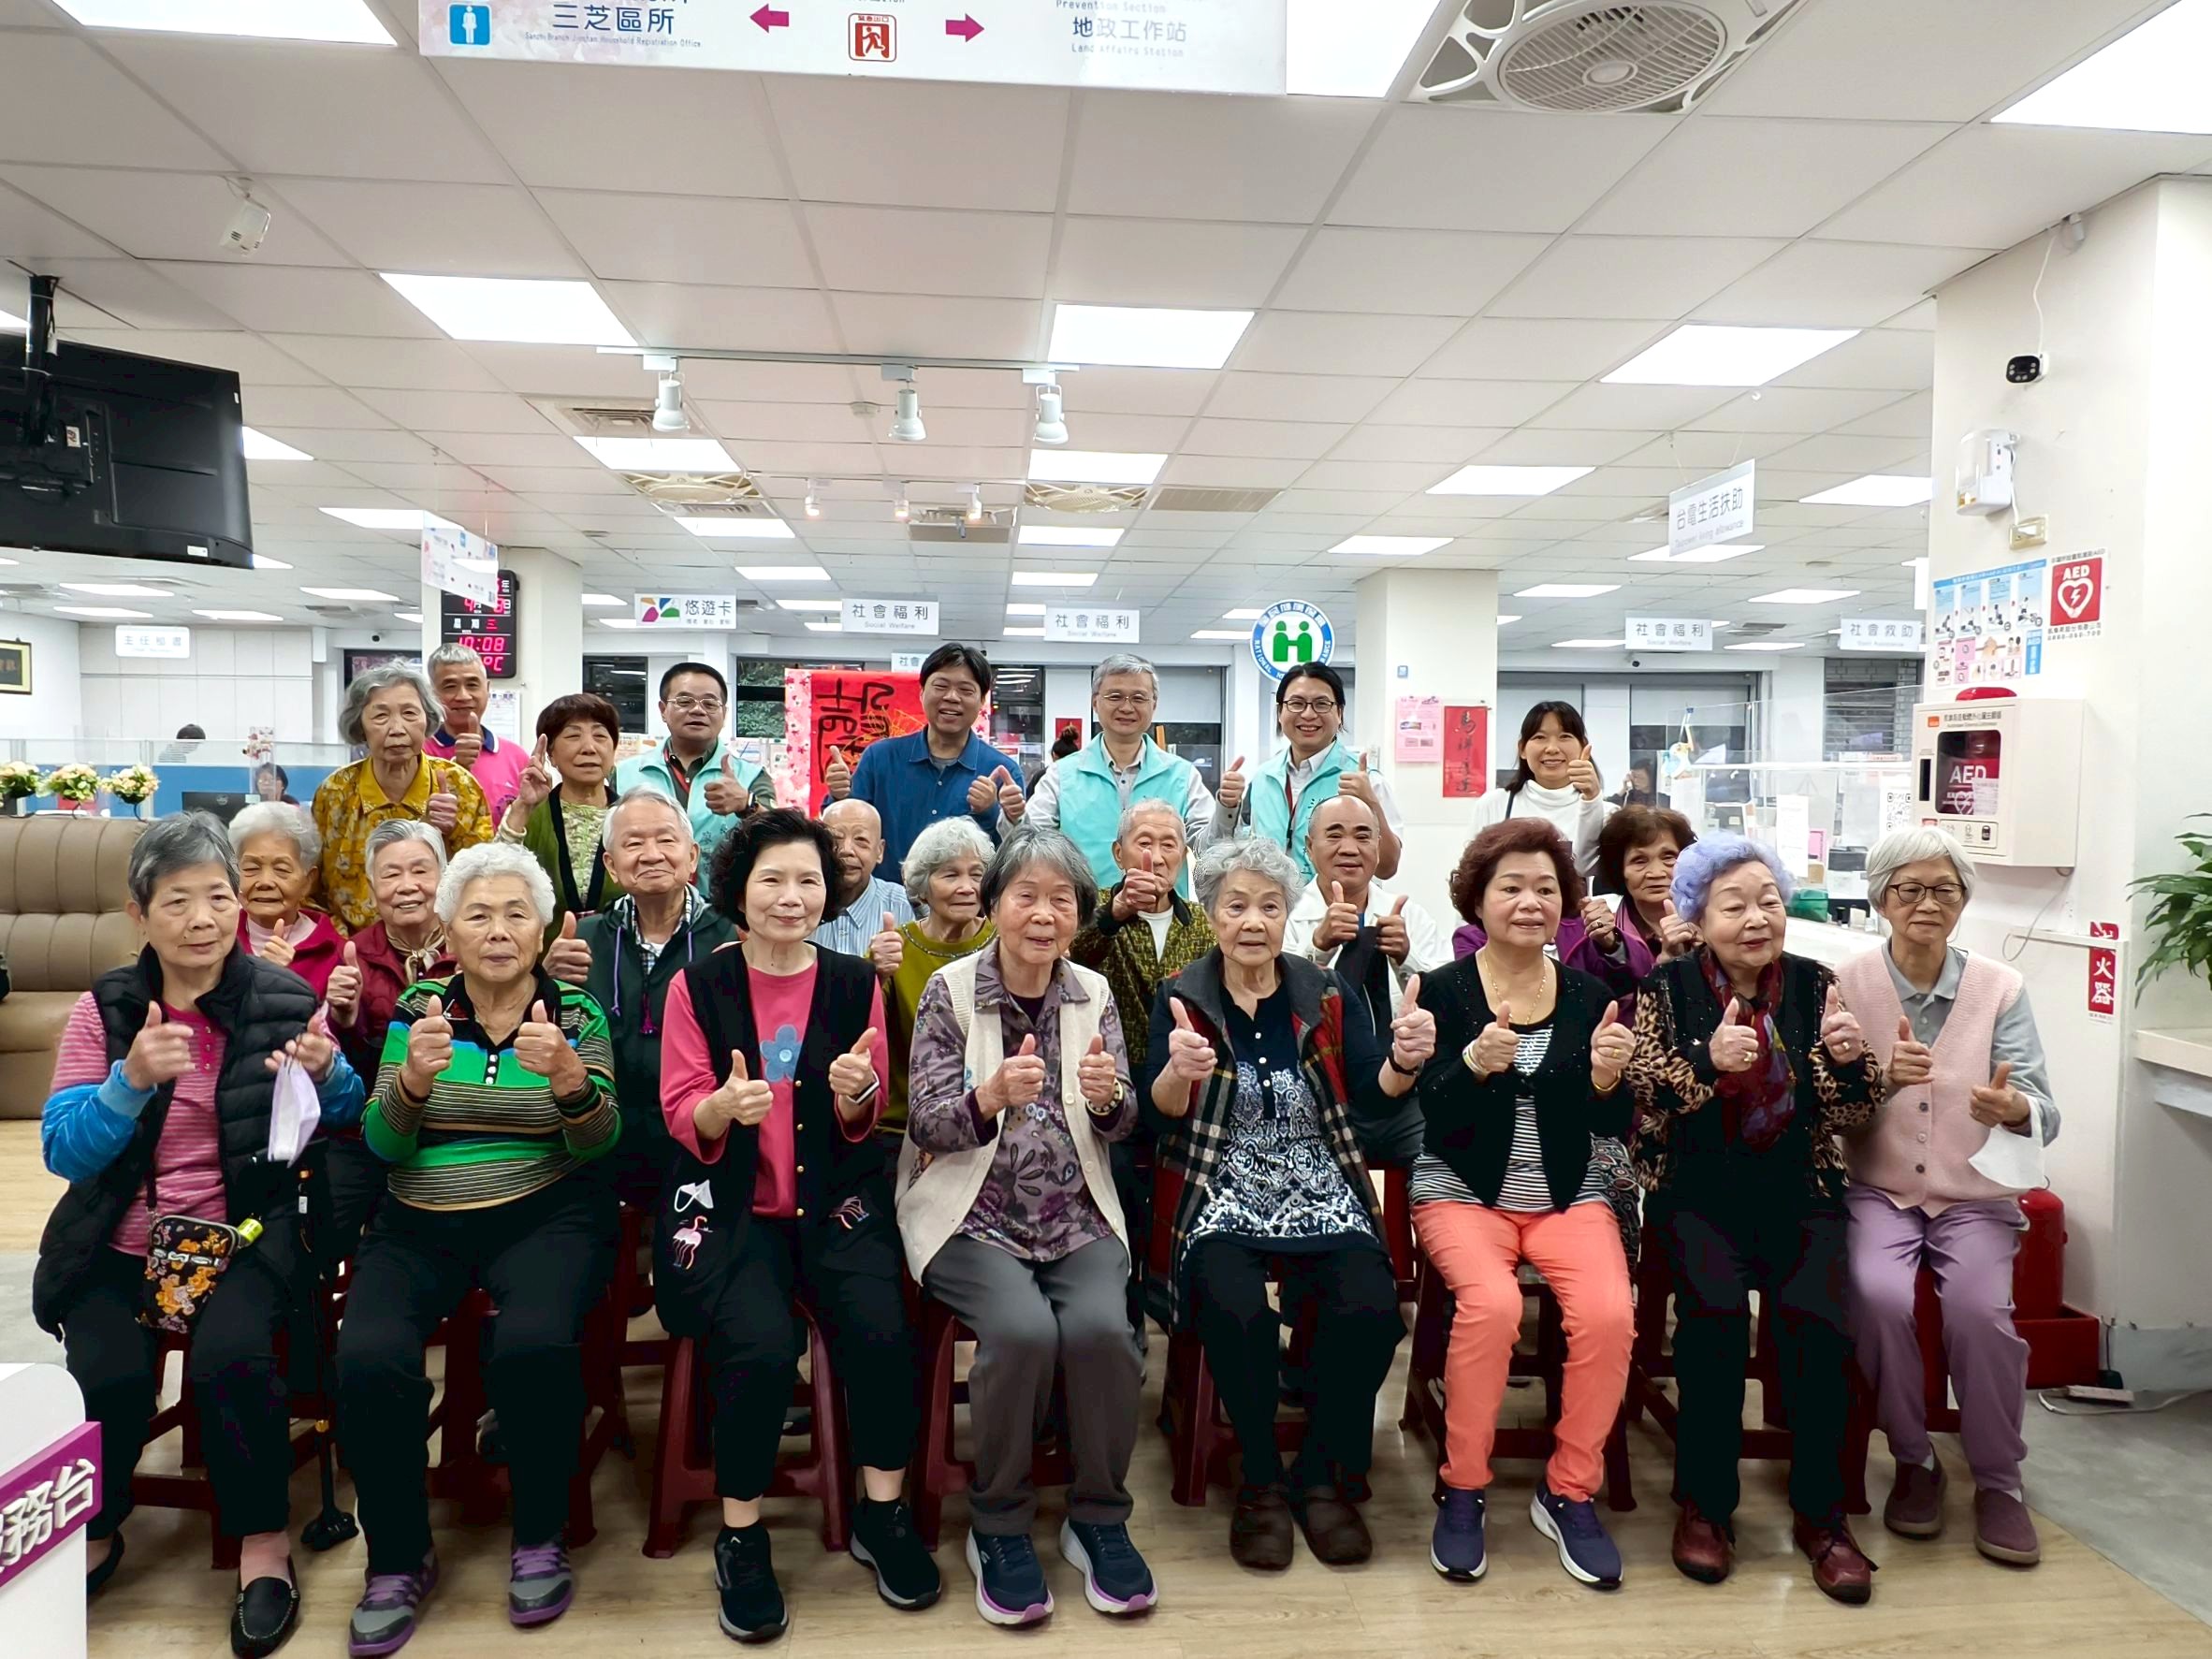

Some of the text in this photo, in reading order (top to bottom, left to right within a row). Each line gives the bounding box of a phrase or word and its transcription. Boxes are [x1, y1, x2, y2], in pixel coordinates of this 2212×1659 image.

[552, 4, 675, 35] 三芝區所
[1072, 16, 1187, 42] 地政工作站
[1677, 487, 1743, 531] 台電生活扶助
[2062, 564, 2090, 581] AED
[685, 600, 732, 616] 悠遊卡
[852, 604, 928, 619] 社會福利
[1055, 614, 1129, 629] 社會福利
[1636, 623, 1703, 637] 社會福利
[458, 636, 505, 652] 10:08
[1949, 765, 1986, 784] AED
[0, 1459, 95, 1573] 務台
